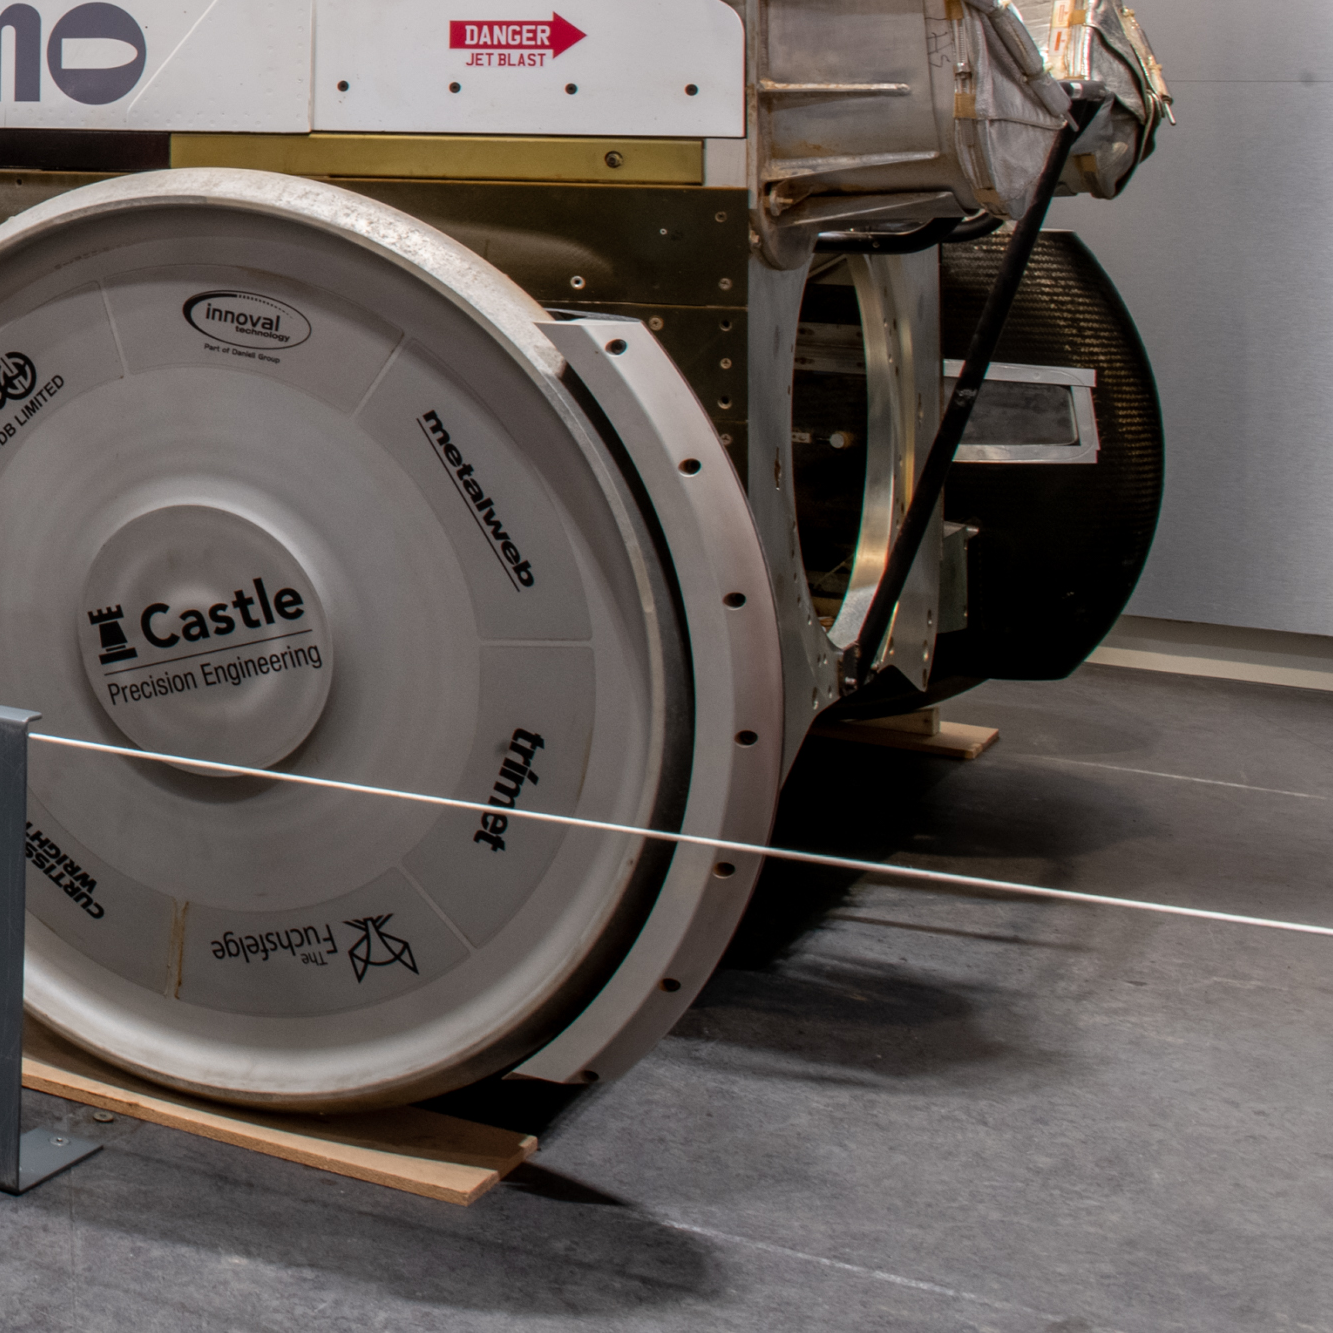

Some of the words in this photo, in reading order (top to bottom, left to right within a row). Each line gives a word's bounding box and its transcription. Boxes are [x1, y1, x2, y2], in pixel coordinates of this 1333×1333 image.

[464, 24, 551, 46] DANGER
[465, 52, 494, 67] JET
[497, 52, 547, 67] BLAST
[205, 302, 281, 332] innoval
[235, 325, 291, 343] technology
[203, 342, 220, 353] Part
[258, 353, 281, 364] Group
[14, 374, 65, 427] LIMITED
[422, 409, 535, 588] metalweb
[140, 577, 305, 649] Castle
[107, 671, 199, 706] Precision
[199, 644, 323, 687] Engineering
[210, 924, 339, 964] Fuchsfelge
[301, 950, 329, 967] The
